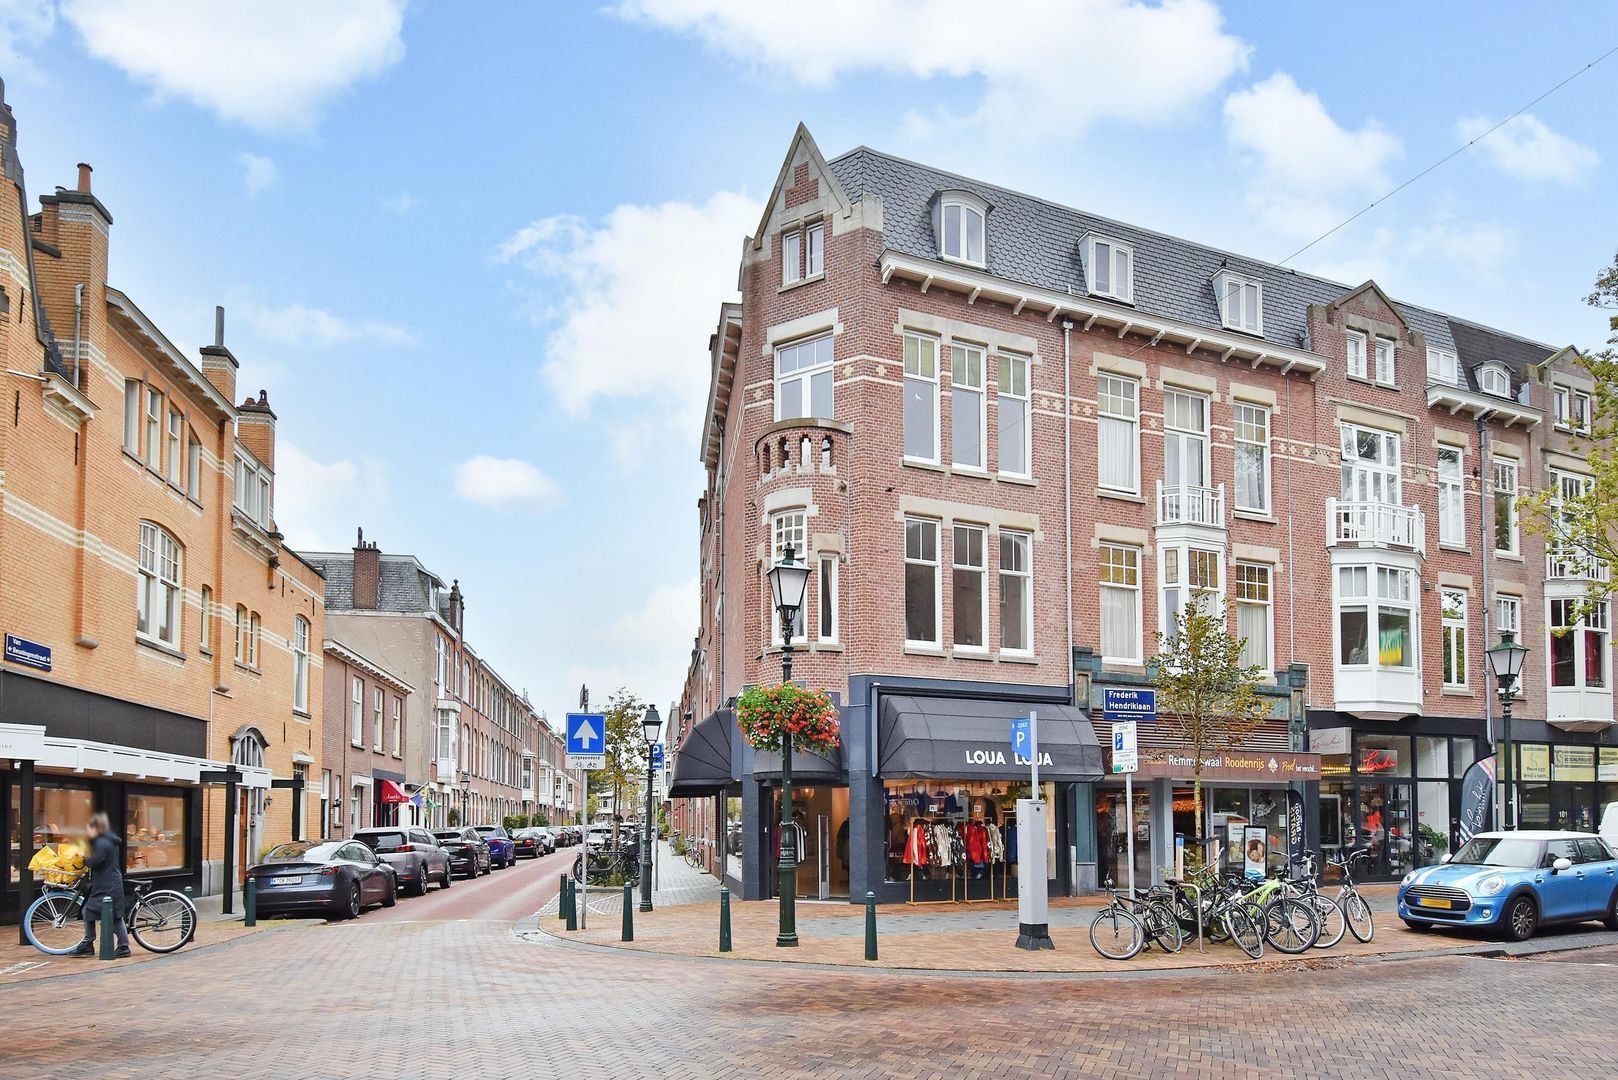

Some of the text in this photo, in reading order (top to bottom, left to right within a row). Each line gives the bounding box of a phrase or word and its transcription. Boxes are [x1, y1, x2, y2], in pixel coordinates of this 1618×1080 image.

[1109, 690, 1139, 699] Frederik
[1109, 701, 1151, 711] Hendriklaan
[1016, 731, 1025, 748] P
[965, 750, 1007, 765] LOUA
[1225, 757, 1265, 771] Roodenrijs
